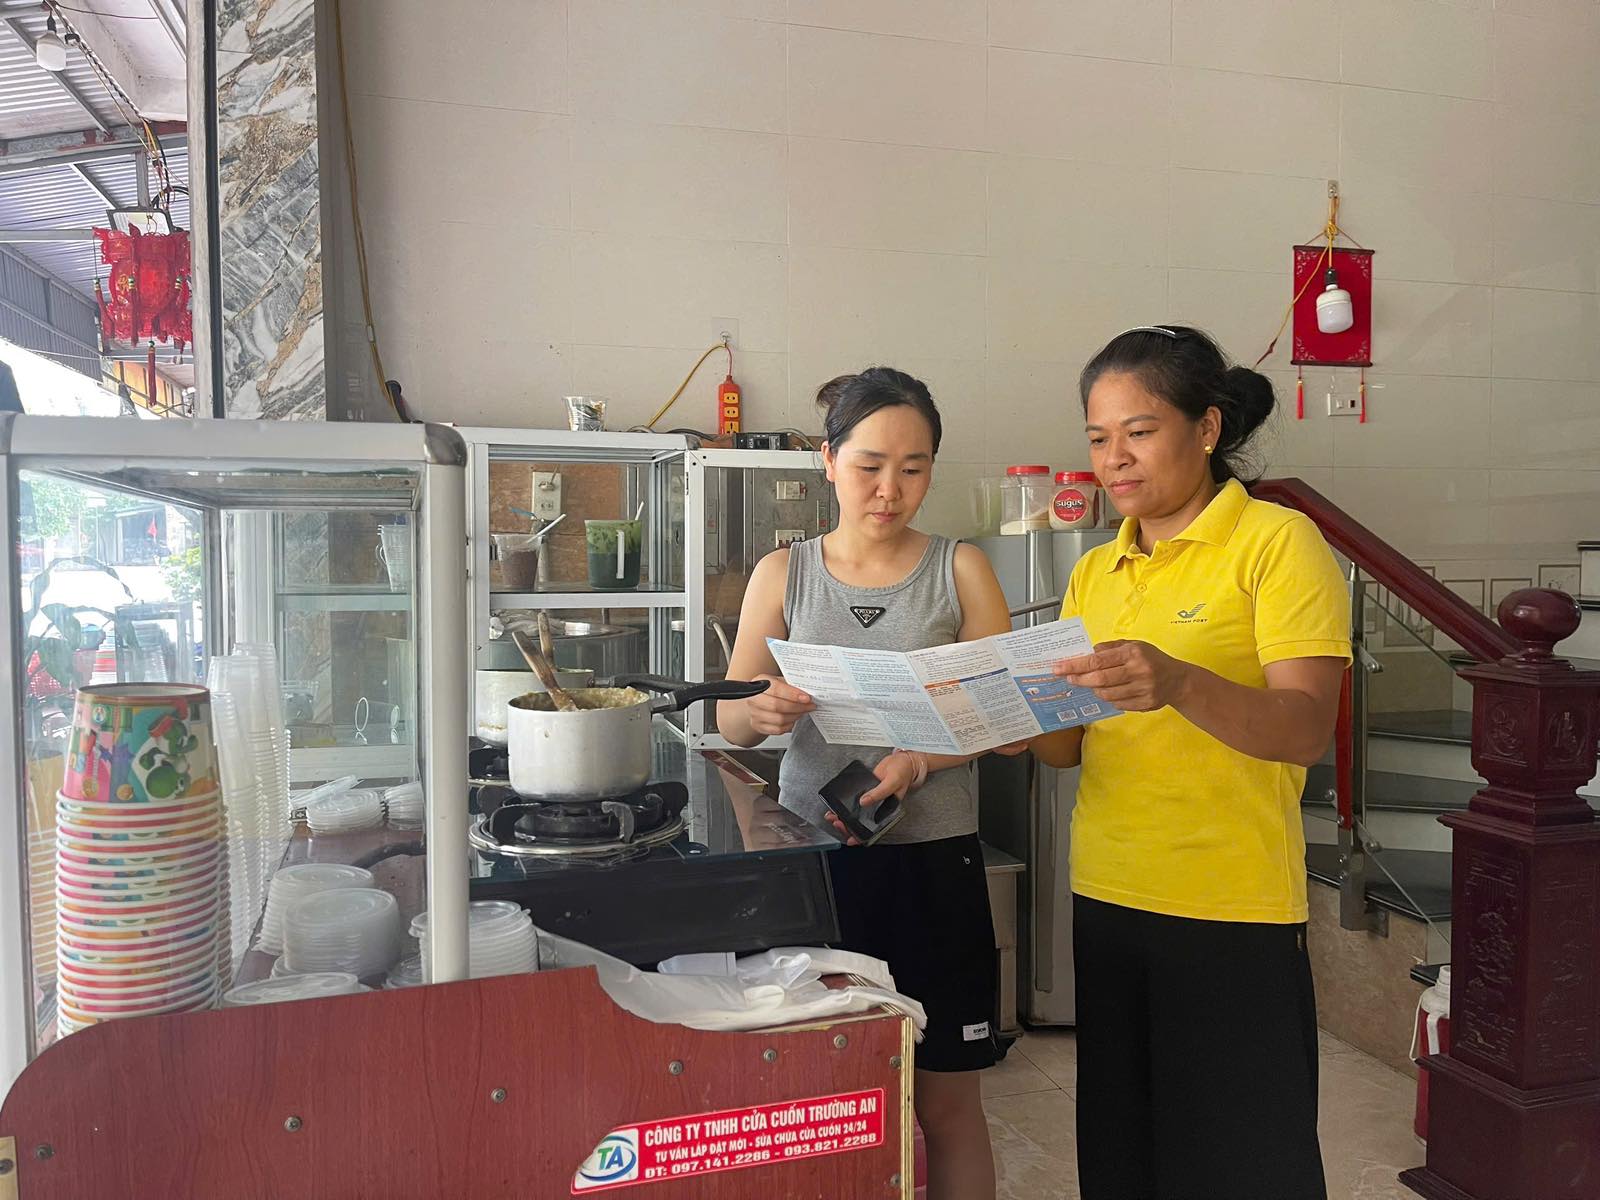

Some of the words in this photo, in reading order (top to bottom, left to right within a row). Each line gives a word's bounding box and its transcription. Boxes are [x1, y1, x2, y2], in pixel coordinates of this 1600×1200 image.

[1056, 499, 1083, 509] sugus
[645, 1125, 682, 1147] CÔNG
[685, 1123, 700, 1140] TY
[704, 1118, 738, 1137] TNHH
[742, 1110, 768, 1132] CỬA
[771, 1103, 805, 1128] CUỐN
[808, 1099, 857, 1122] TRƯỜNG
[859, 1096, 876, 1114] AN
[843, 1119, 867, 1134] 24/24
[597, 1145, 624, 1170] TA
[671, 1150, 771, 1174] 097.141.2286
[784, 1132, 877, 1157] 093.821.2288
